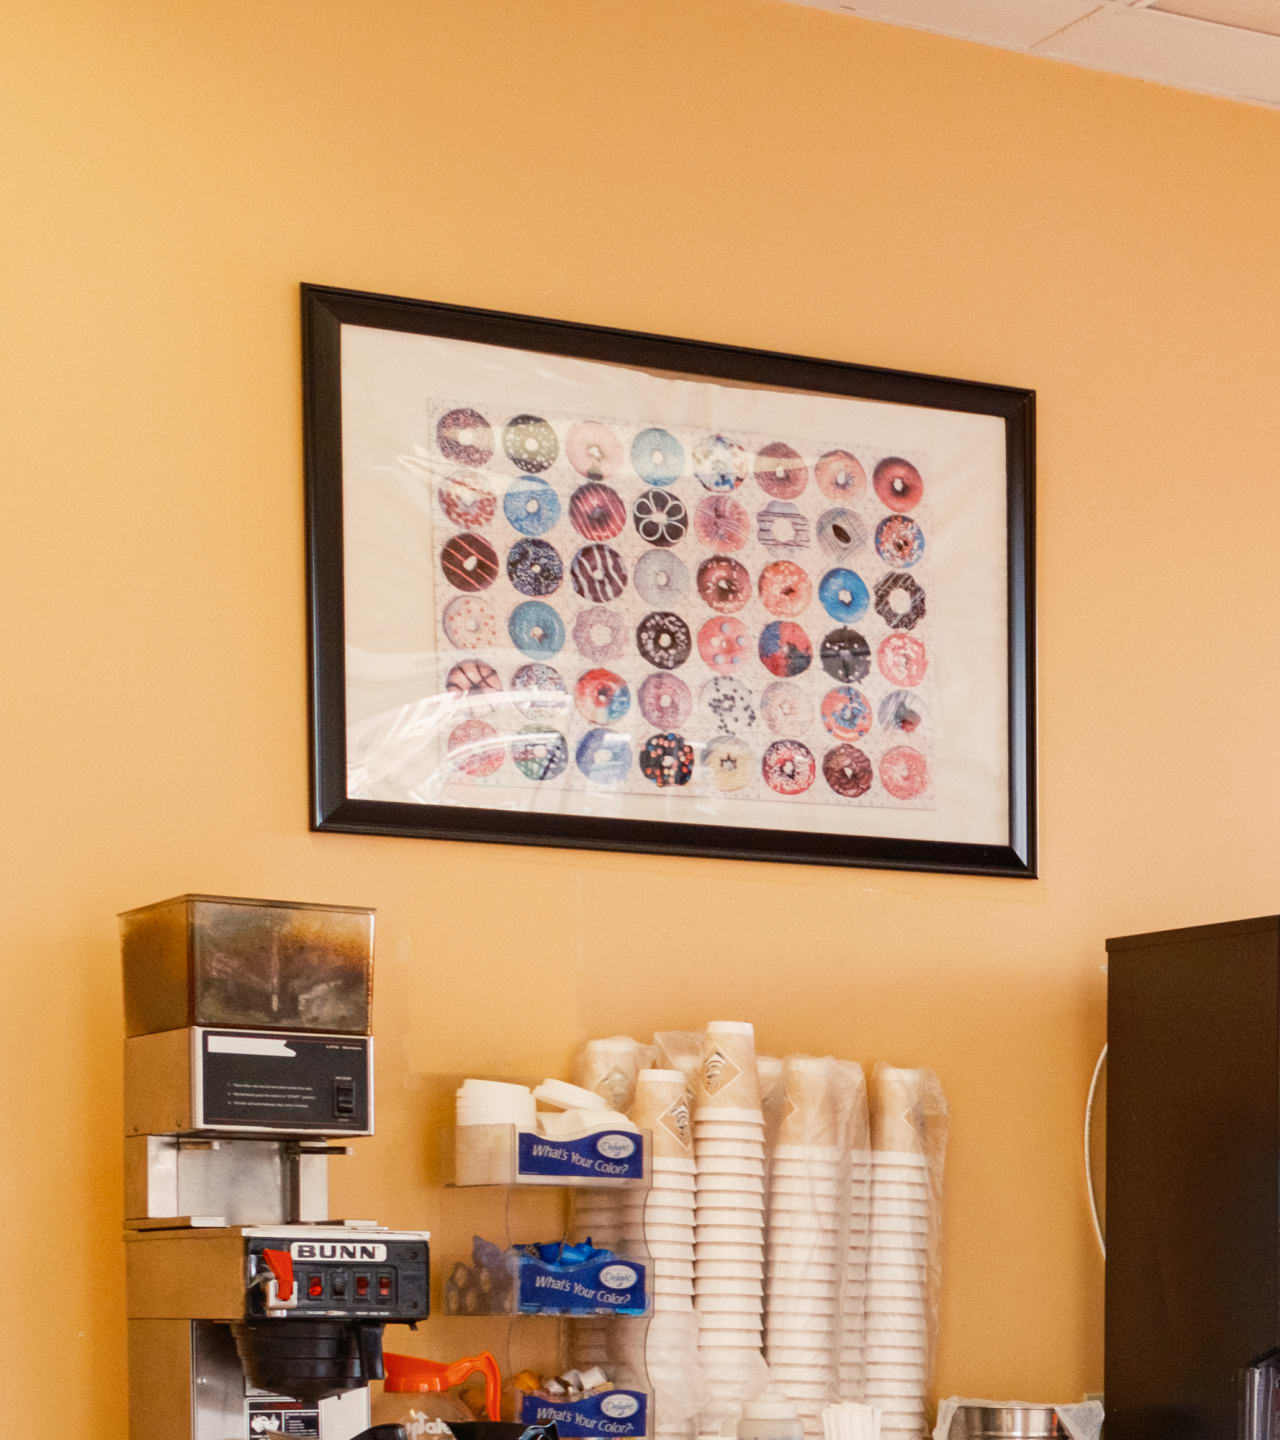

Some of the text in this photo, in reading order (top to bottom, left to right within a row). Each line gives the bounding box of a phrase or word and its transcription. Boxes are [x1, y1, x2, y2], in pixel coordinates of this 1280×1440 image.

[533, 1145, 629, 1175] What's Your Color?
[297, 1245, 376, 1259] BUNN
[536, 1276, 630, 1304] What's Your Color?
[537, 1407, 631, 1433] What's Your Color?
